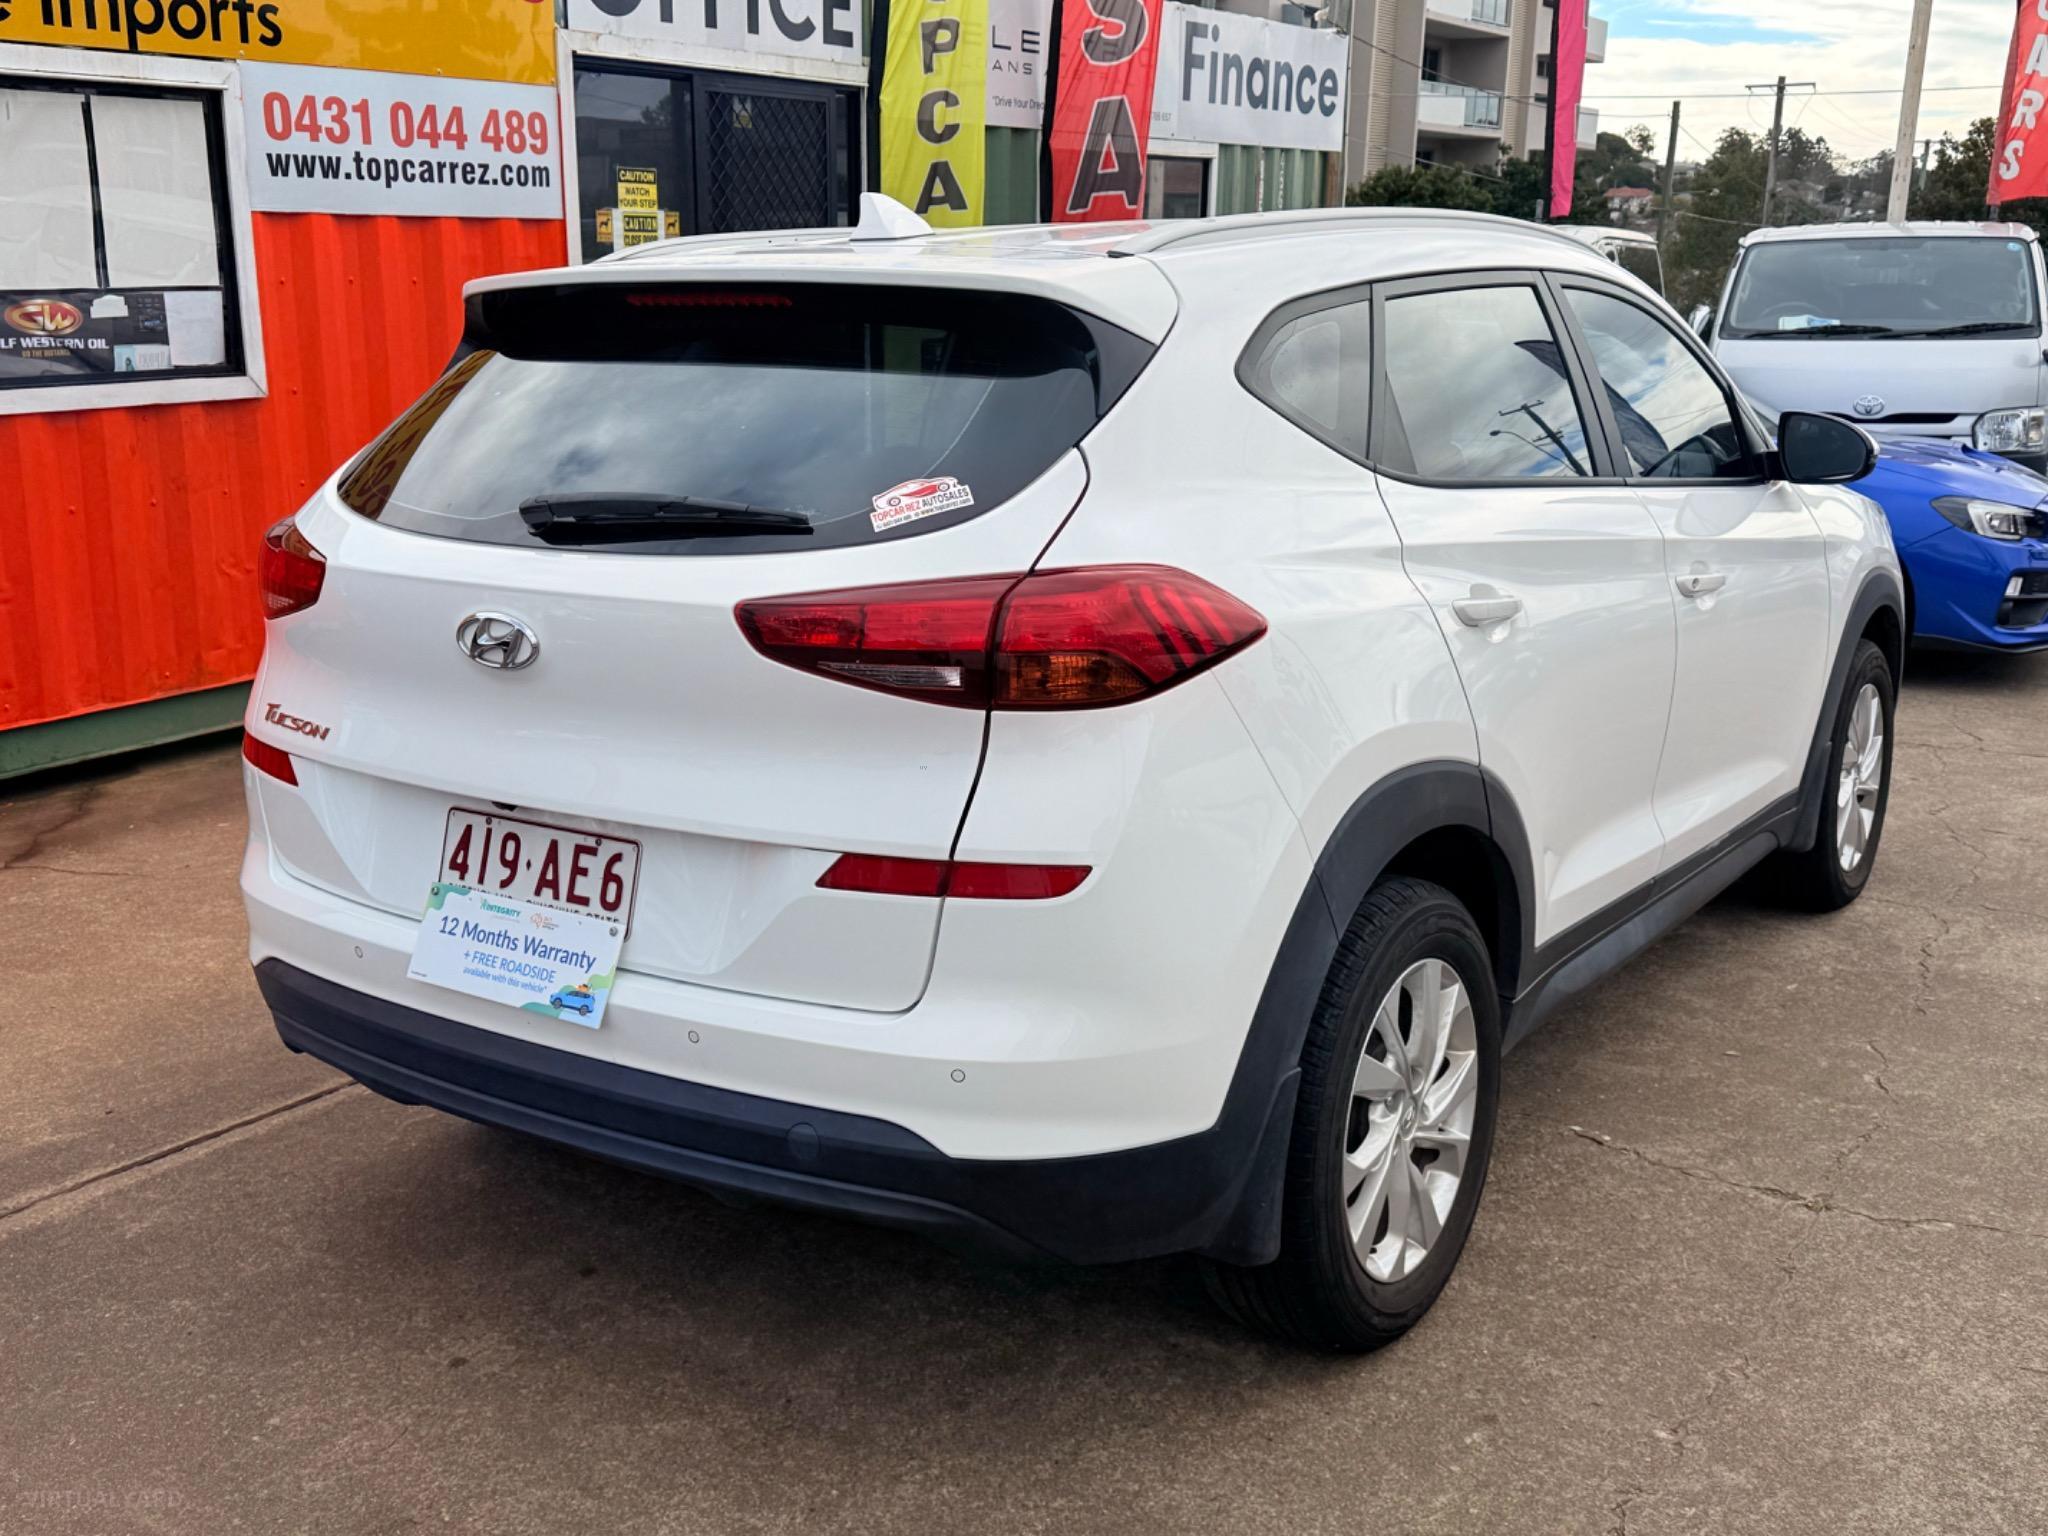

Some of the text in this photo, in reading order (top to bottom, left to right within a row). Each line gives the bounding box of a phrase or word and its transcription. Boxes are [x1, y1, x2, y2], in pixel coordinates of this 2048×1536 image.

[1183, 21, 1338, 117] Finance
[263, 92, 548, 155] 0431 044 489
[267, 151, 551, 188] www.topcarrez.com
[620, 170, 655, 182] CAUTION
[620, 199, 656, 208] YOUR STEP
[625, 187, 650, 196] WATCH
[624, 217, 657, 230] CAUTION
[88, 338, 110, 349] OIL
[873, 506, 905, 522] TOPCAR
[906, 501, 921, 513] REZ
[922, 487, 969, 507] AUTOSALES
[439, 915, 459, 936] 12
[461, 920, 519, 951] Months
[523, 935, 597, 973] Warranty
[463, 967, 491, 980] available
[491, 974, 507, 983] with
[507, 976, 520, 987] this
[472, 951, 500, 969] FREE
[499, 958, 557, 983] ROADSIDE
